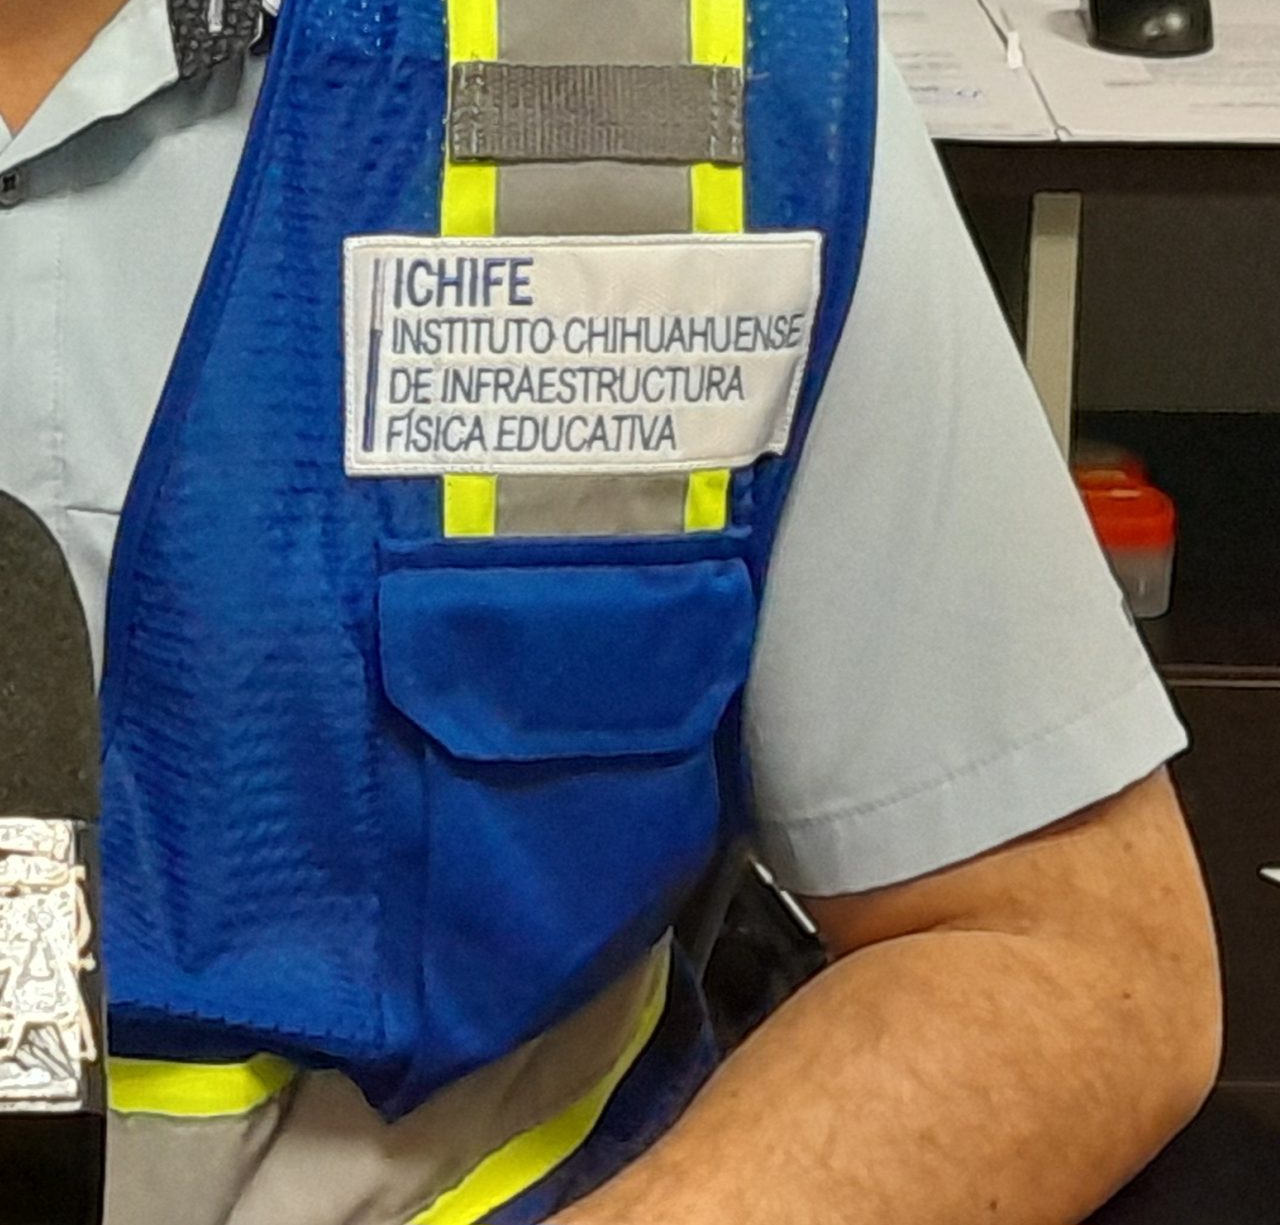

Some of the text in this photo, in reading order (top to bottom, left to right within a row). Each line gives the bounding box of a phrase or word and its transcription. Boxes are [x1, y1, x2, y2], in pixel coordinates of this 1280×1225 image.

[393, 257, 534, 309] ICHIFE
[391, 313, 806, 356] INSTITUTO CHIHUAHUENSE
[389, 365, 745, 404] DE INFRAESTRUCTURA
[386, 408, 677, 452] FÍSICA EDUCATIVA
